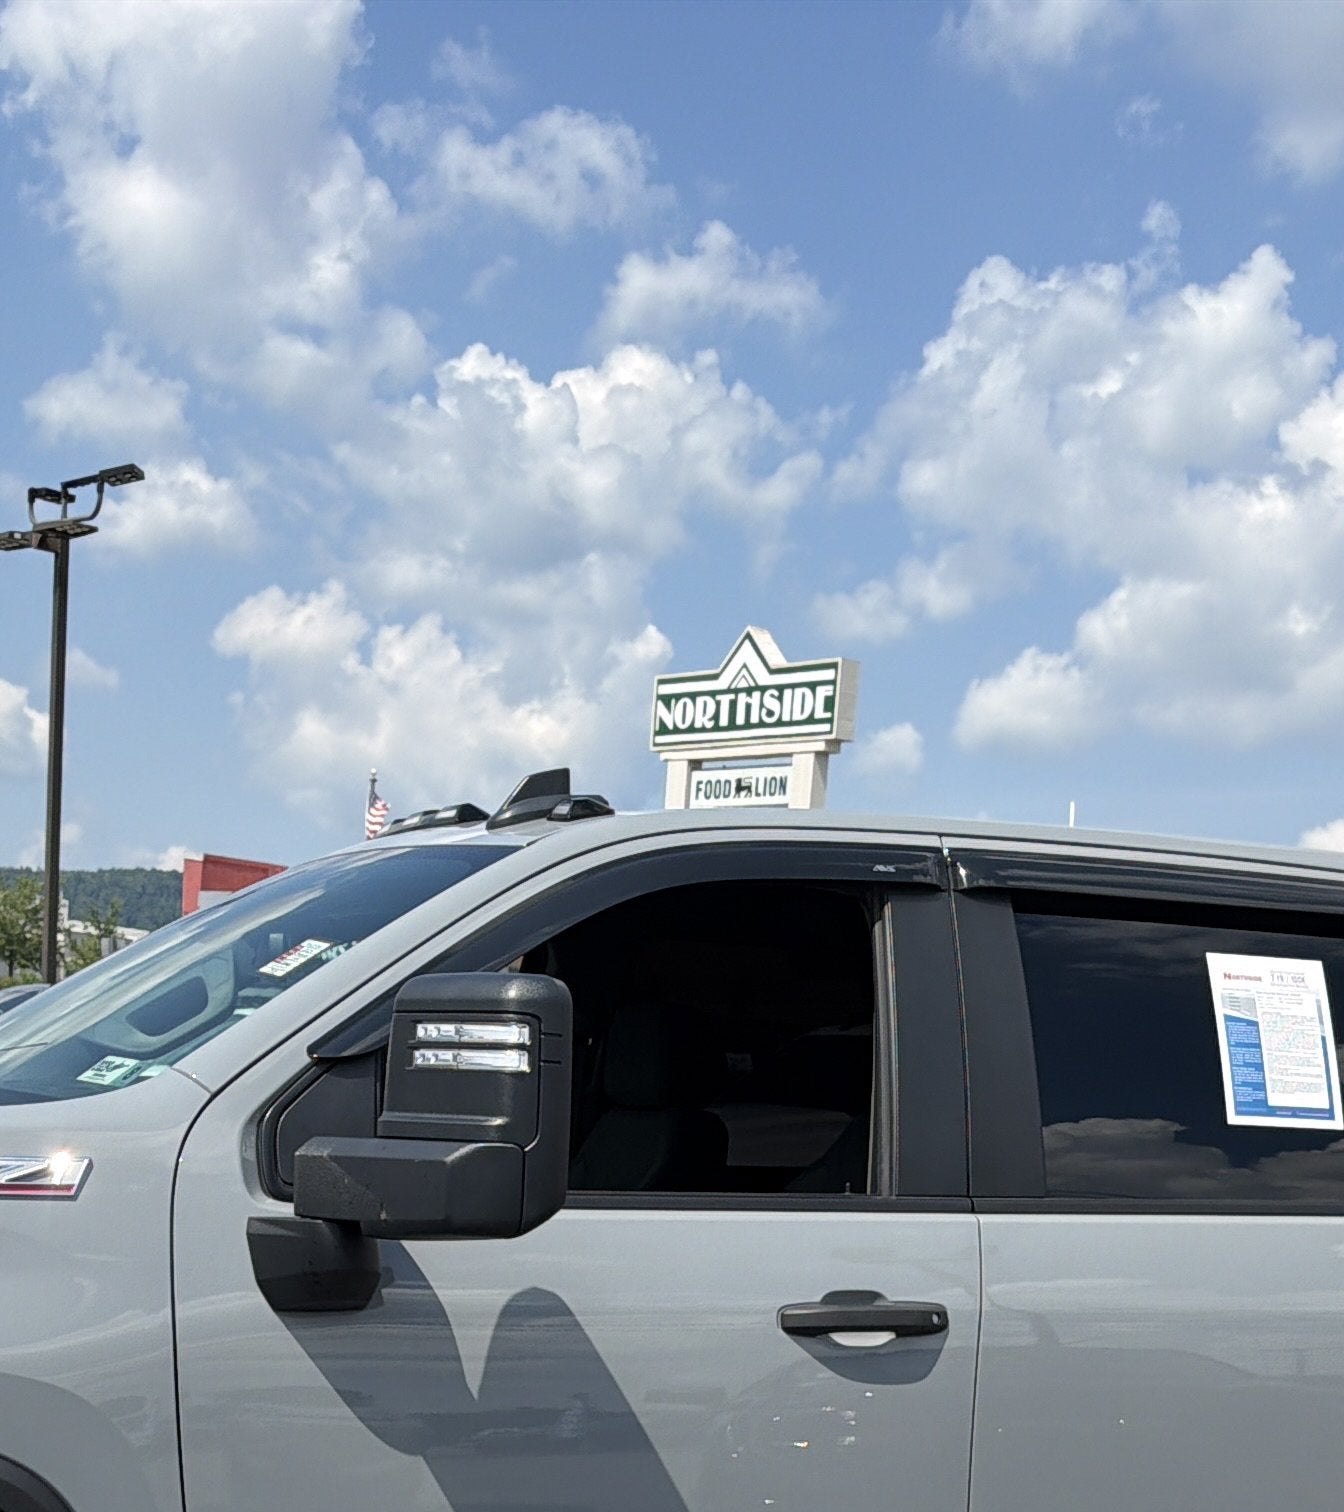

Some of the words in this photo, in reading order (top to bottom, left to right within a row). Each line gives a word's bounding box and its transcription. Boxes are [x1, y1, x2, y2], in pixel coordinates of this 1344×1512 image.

[655, 684, 835, 732] NORTHSIDE
[695, 779, 732, 801] FOOD
[754, 775, 788, 798] LION
